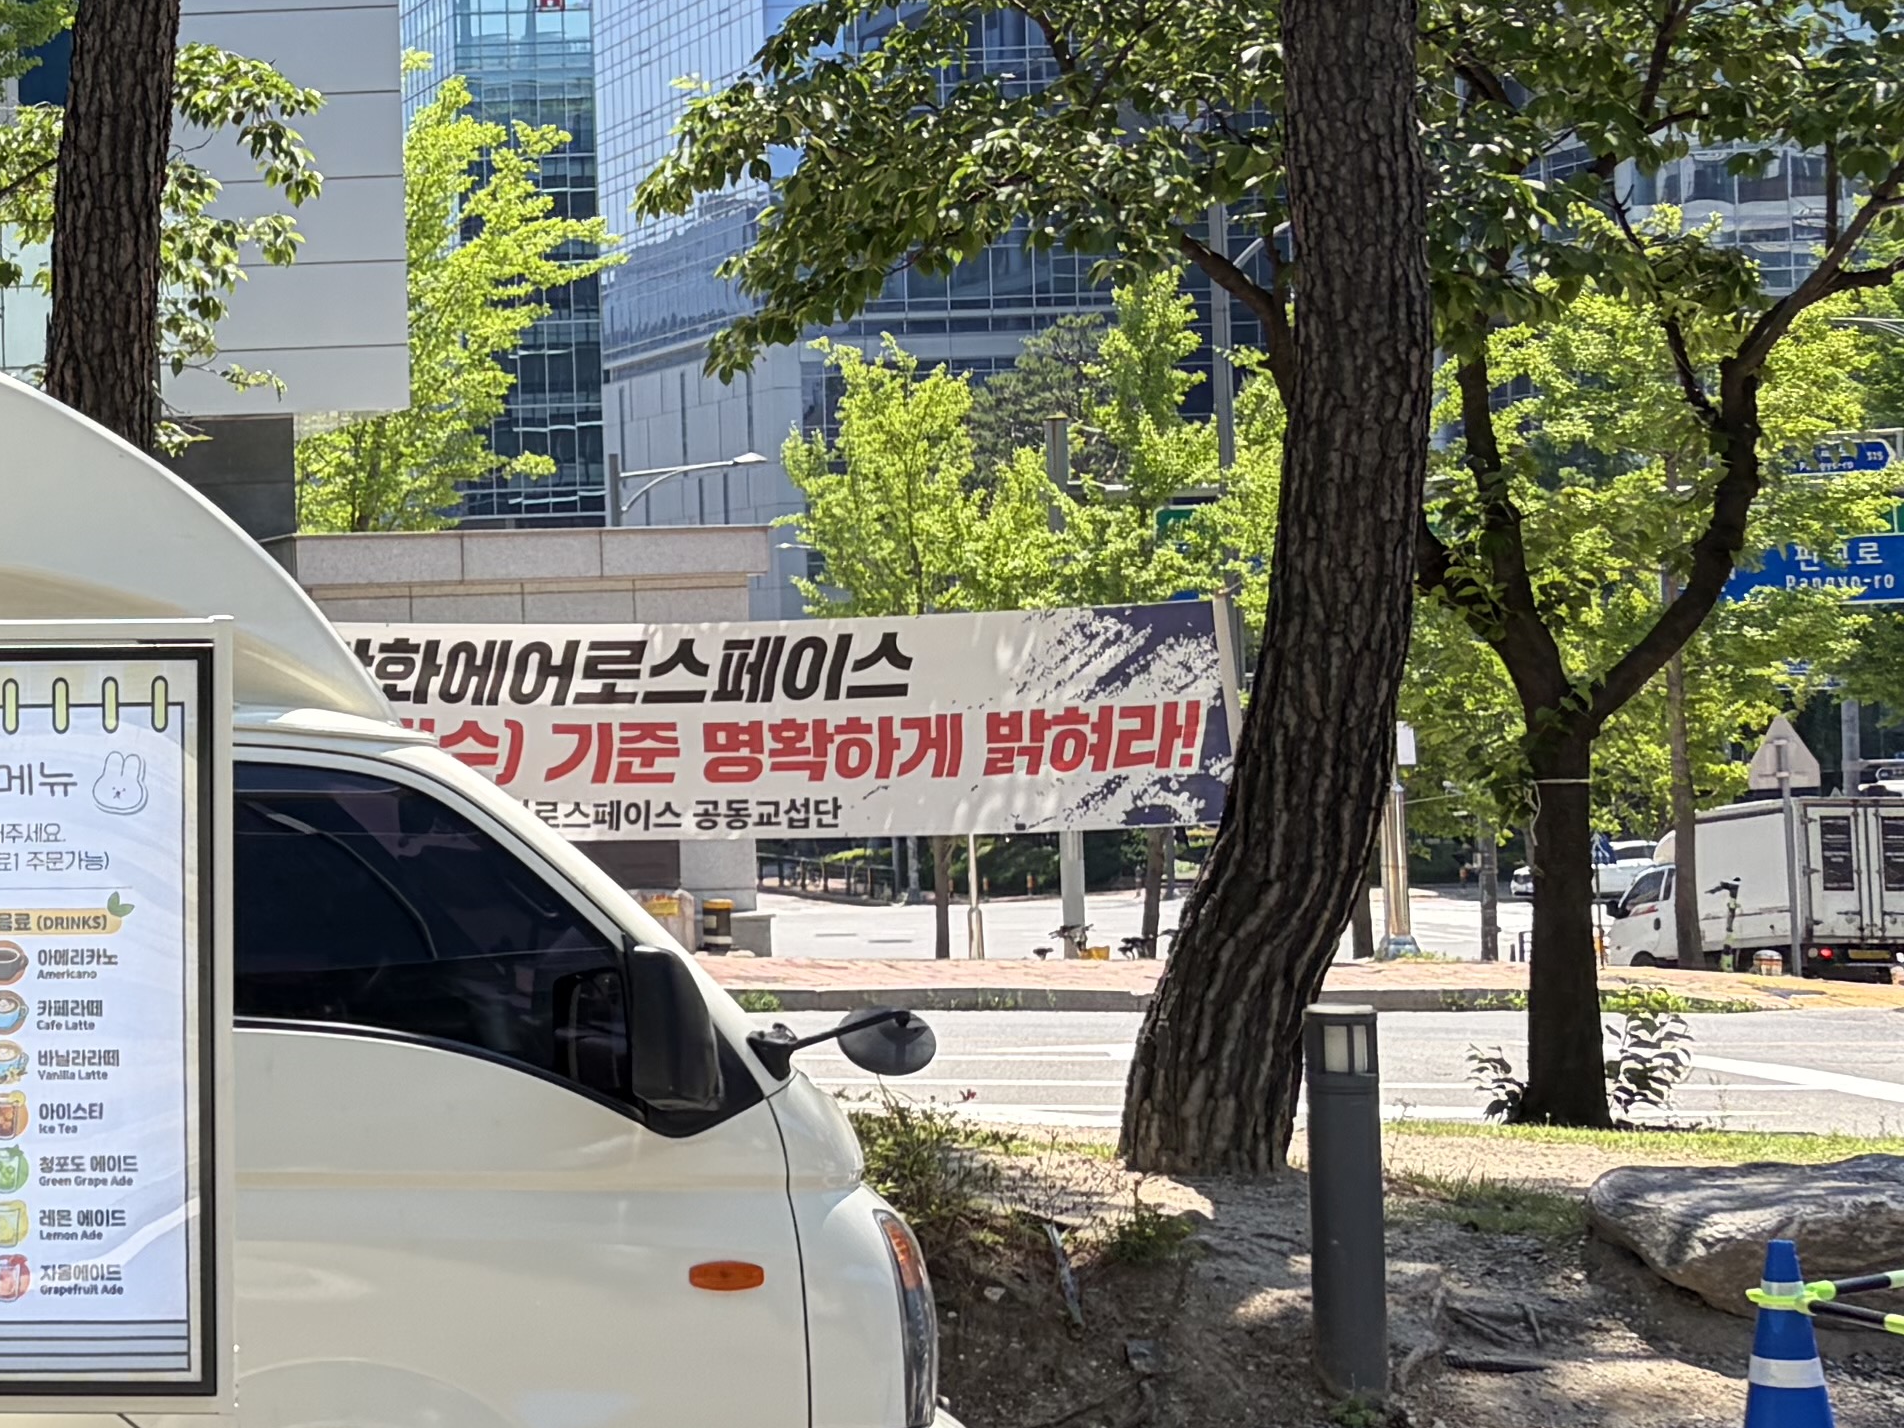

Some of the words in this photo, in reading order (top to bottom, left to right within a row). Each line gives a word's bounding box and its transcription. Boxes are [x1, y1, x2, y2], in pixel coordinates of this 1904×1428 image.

[1794, 542, 1884, 571] 판로
[400, 718, 524, 786] 수)
[546, 719, 681, 785] 기준
[702, 713, 963, 785] 명확하게
[983, 700, 1199, 775] 밝혀라!
[524, 798, 683, 832] 로스페이스
[692, 796, 843, 832] 공동교섭단
[26, 851, 111, 873] 주문가능)
[36, 913, 108, 932] (DRINKS)
[37, 948, 119, 967] 아메리카노
[36, 969, 98, 981] Americano
[37, 999, 103, 1018] 카페라떼
[36, 1020, 61, 1031] Cafe
[65, 1020, 95, 1031] Latte
[37, 1049, 120, 1068] 바닐라라떼
[37, 1069, 76, 1080] Vanilla
[79, 1069, 108, 1081] Latte
[38, 1103, 103, 1122] 아이스티
[38, 1123, 54, 1134] Ice
[57, 1123, 78, 1135] Tea
[38, 1155, 86, 1173] 청포도
[90, 1155, 138, 1173] 에이드
[39, 1175, 70, 1186] Green
[74, 1175, 106, 1189] Grape
[109, 1175, 134, 1186] Ade
[38, 1209, 72, 1228] 레몬
[76, 1209, 127, 1228] 에이드
[39, 1230, 78, 1241] Lemon
[80, 1230, 104, 1242] Ade
[40, 1264, 122, 1283] 자몽에이드
[39, 1284, 98, 1298] Grapefruit
[100, 1284, 124, 1296] Ade
